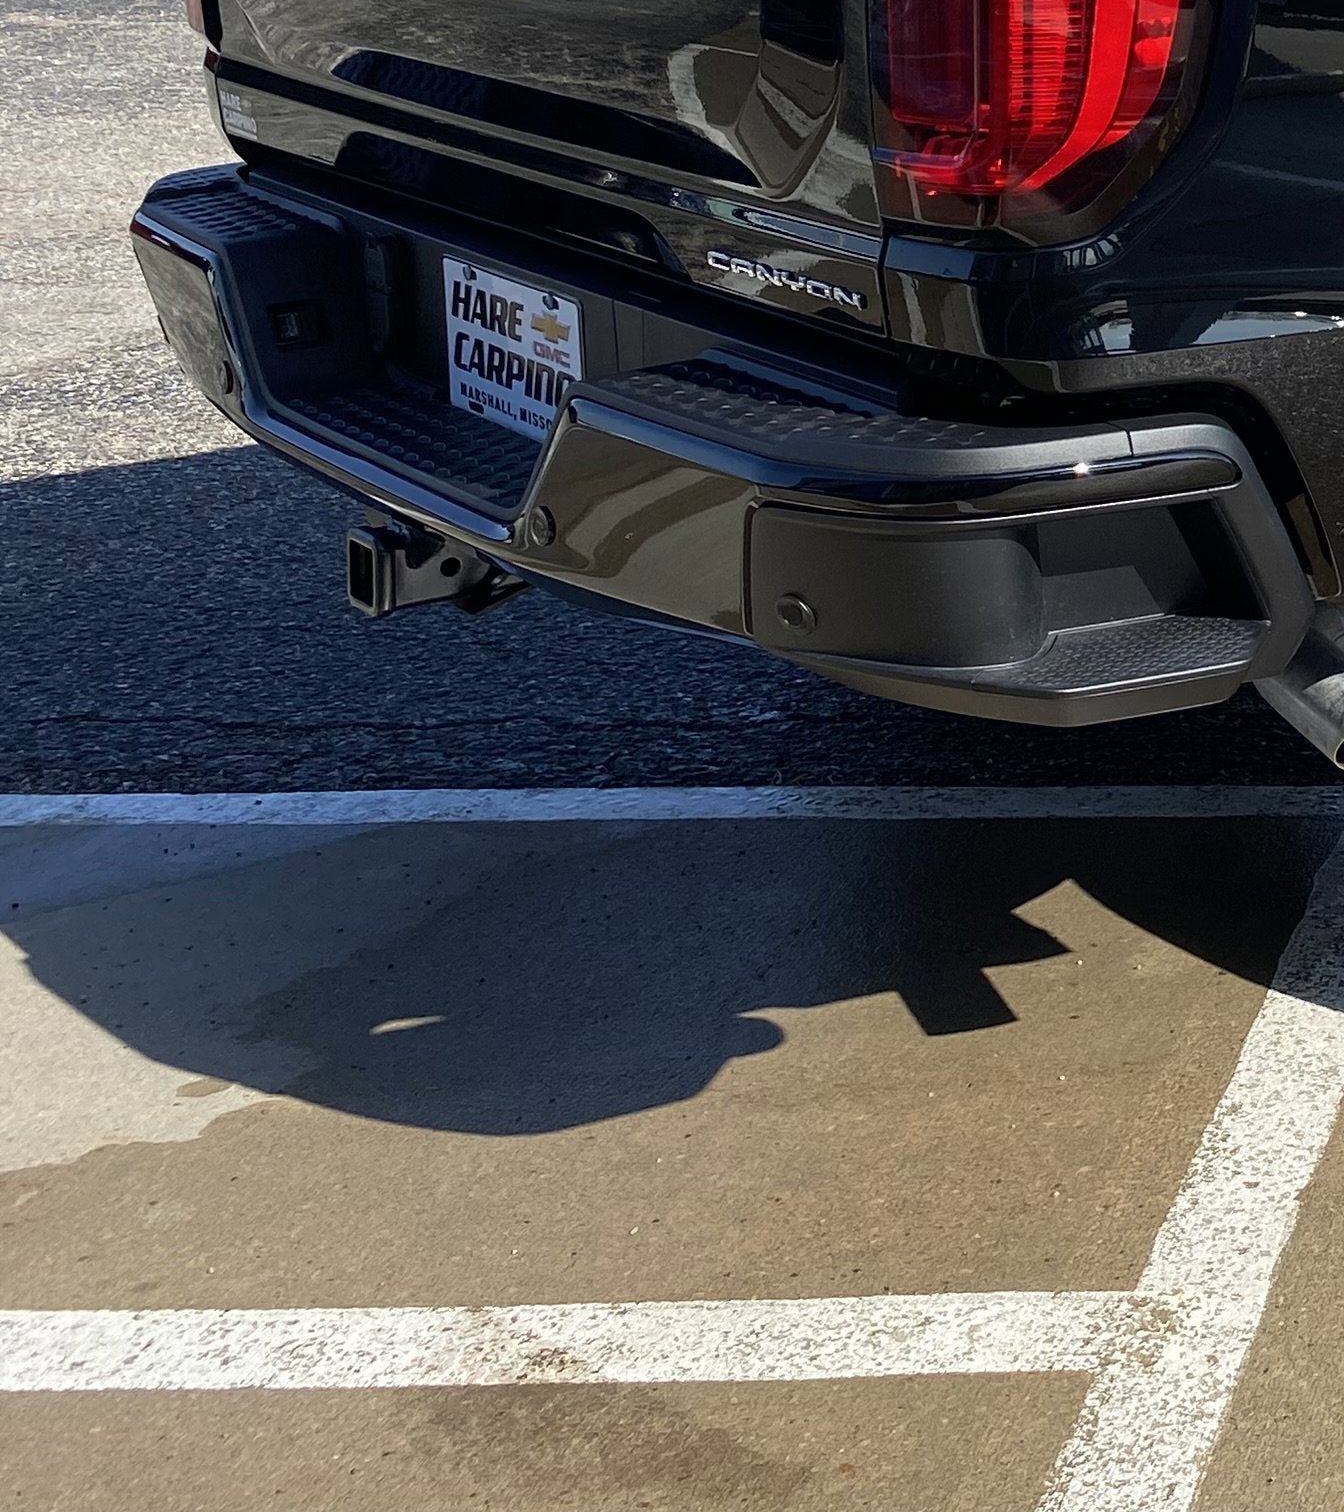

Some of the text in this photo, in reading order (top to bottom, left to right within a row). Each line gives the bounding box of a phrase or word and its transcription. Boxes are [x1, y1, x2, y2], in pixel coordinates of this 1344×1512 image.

[451, 280, 524, 342] HARE
[707, 249, 866, 311] CANYON
[453, 331, 577, 408] CARPINO
[533, 341, 571, 369] GMC
[460, 382, 553, 430] MARSHALL, MISSO
